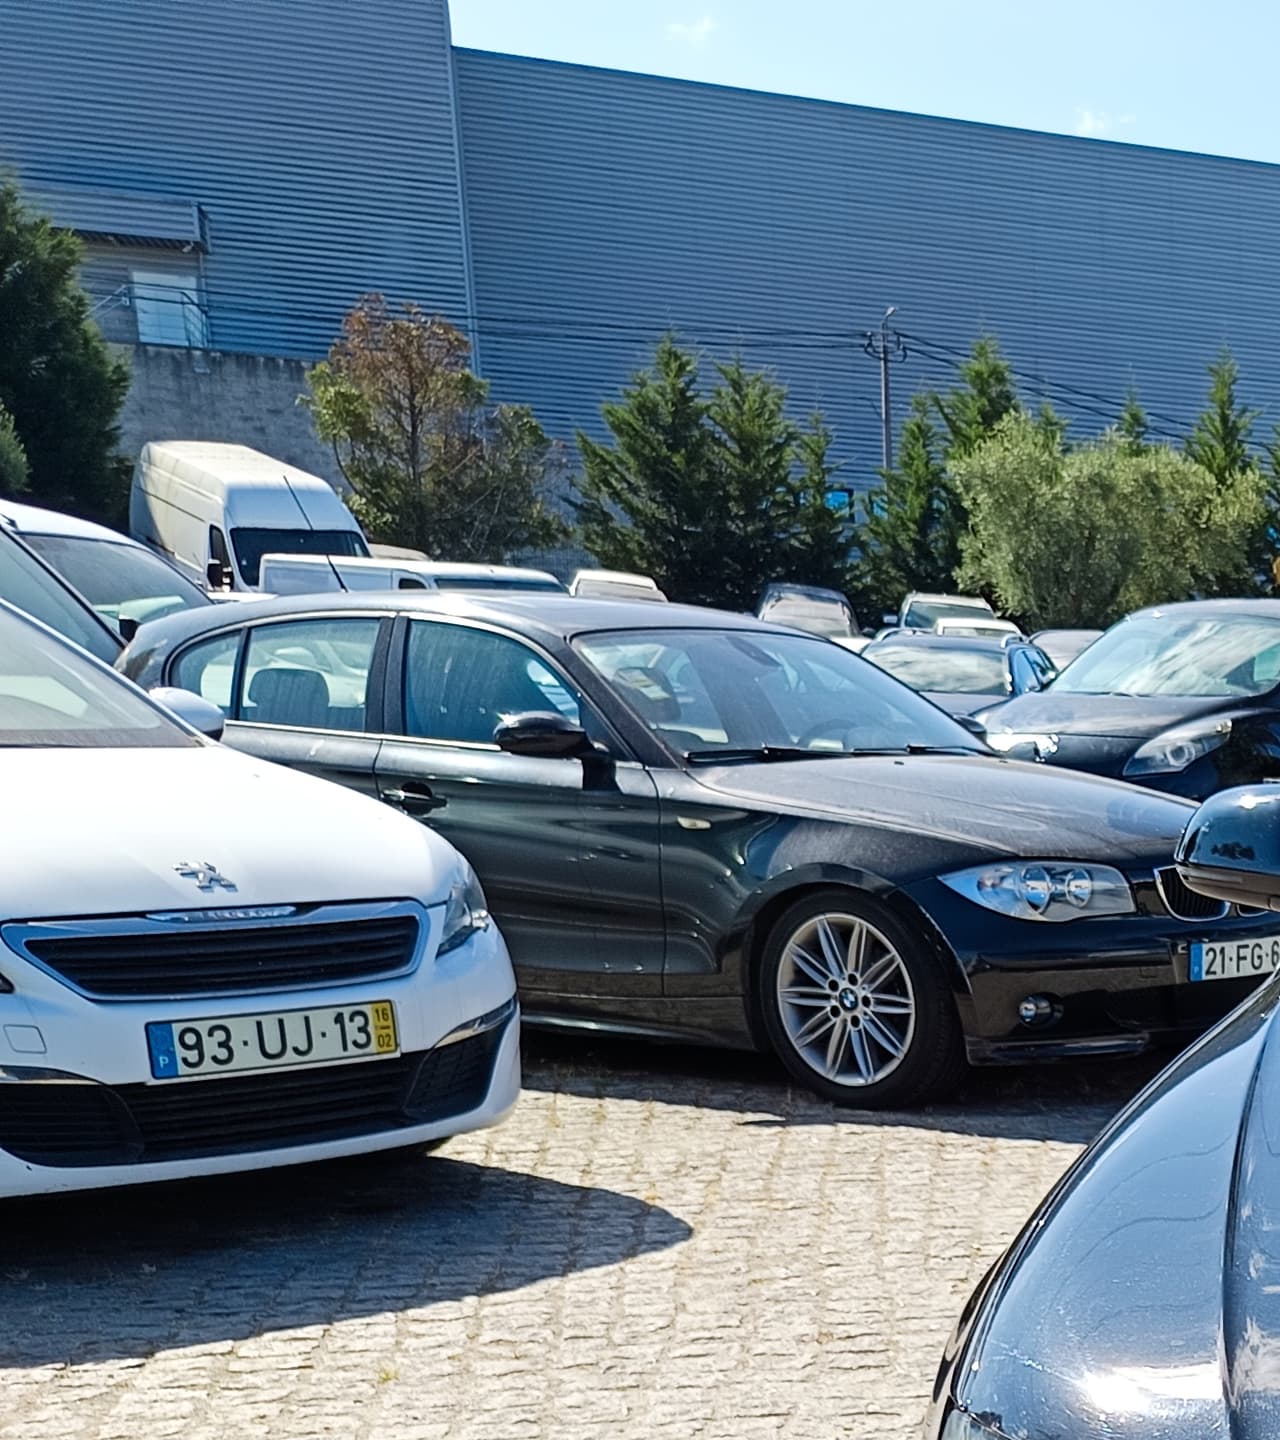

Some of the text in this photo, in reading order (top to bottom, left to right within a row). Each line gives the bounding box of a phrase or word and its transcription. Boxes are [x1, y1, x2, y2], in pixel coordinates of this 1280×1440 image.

[374, 1007, 390, 1022] 16
[377, 1032, 392, 1049] 02
[158, 1056, 169, 1068] P
